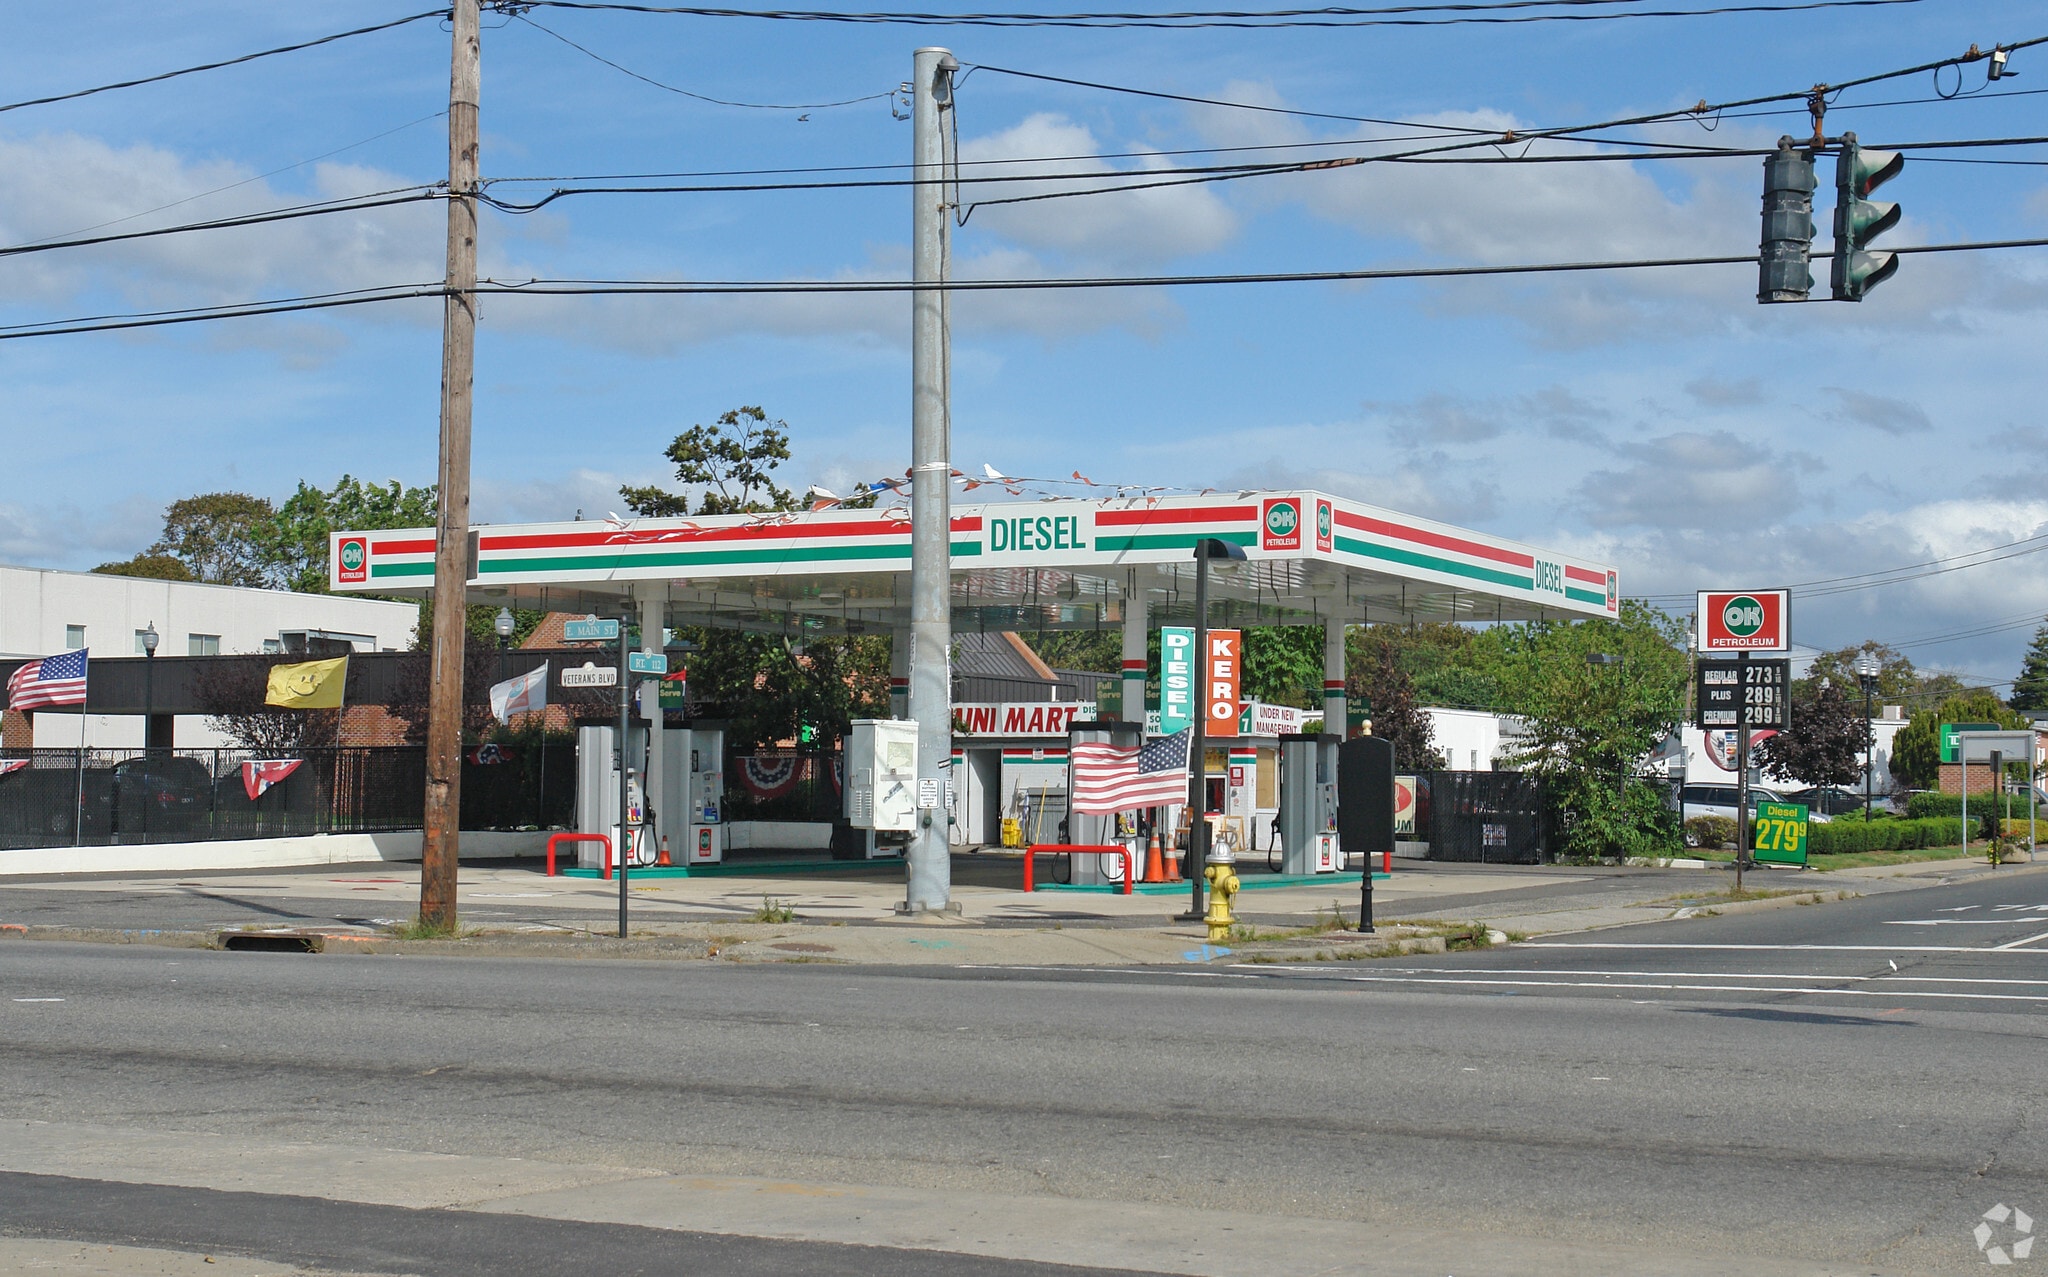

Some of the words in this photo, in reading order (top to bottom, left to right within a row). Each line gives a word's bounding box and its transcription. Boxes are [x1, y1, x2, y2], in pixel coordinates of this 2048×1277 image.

[1268, 511, 1295, 528] OK
[991, 516, 1086, 551] DIESEL
[1266, 538, 1297, 546] PETROLEUM
[343, 549, 362, 562] OK
[1536, 560, 1563, 593] DIESEL
[1725, 606, 1760, 626] OK
[578, 626, 600, 636] MAIN
[1712, 638, 1774, 647] PETROLEUM
[652, 660, 661, 669] 112
[563, 673, 595, 684] VETERANS
[599, 673, 615, 683] BLVD
[1167, 634, 1189, 718] DIESEL
[1211, 639, 1233, 719] KERO
[1704, 670, 1738, 680] REGULAR
[1745, 666, 1772, 683] 273
[1710, 690, 1732, 700] PLUS
[1745, 686, 1773, 703] 289
[1348, 698, 1362, 706] Full
[1083, 706, 1097, 714] DIS
[1259, 706, 1280, 720] UNDER
[1281, 709, 1295, 721] NEW
[1348, 706, 1369, 714] Serve
[1703, 710, 1737, 720] PREMIUM
[1745, 706, 1773, 724] 299
[1003, 706, 1079, 732] MART
[1256, 721, 1297, 734] MANAGEMENT
[1767, 805, 1798, 817] Diesel
